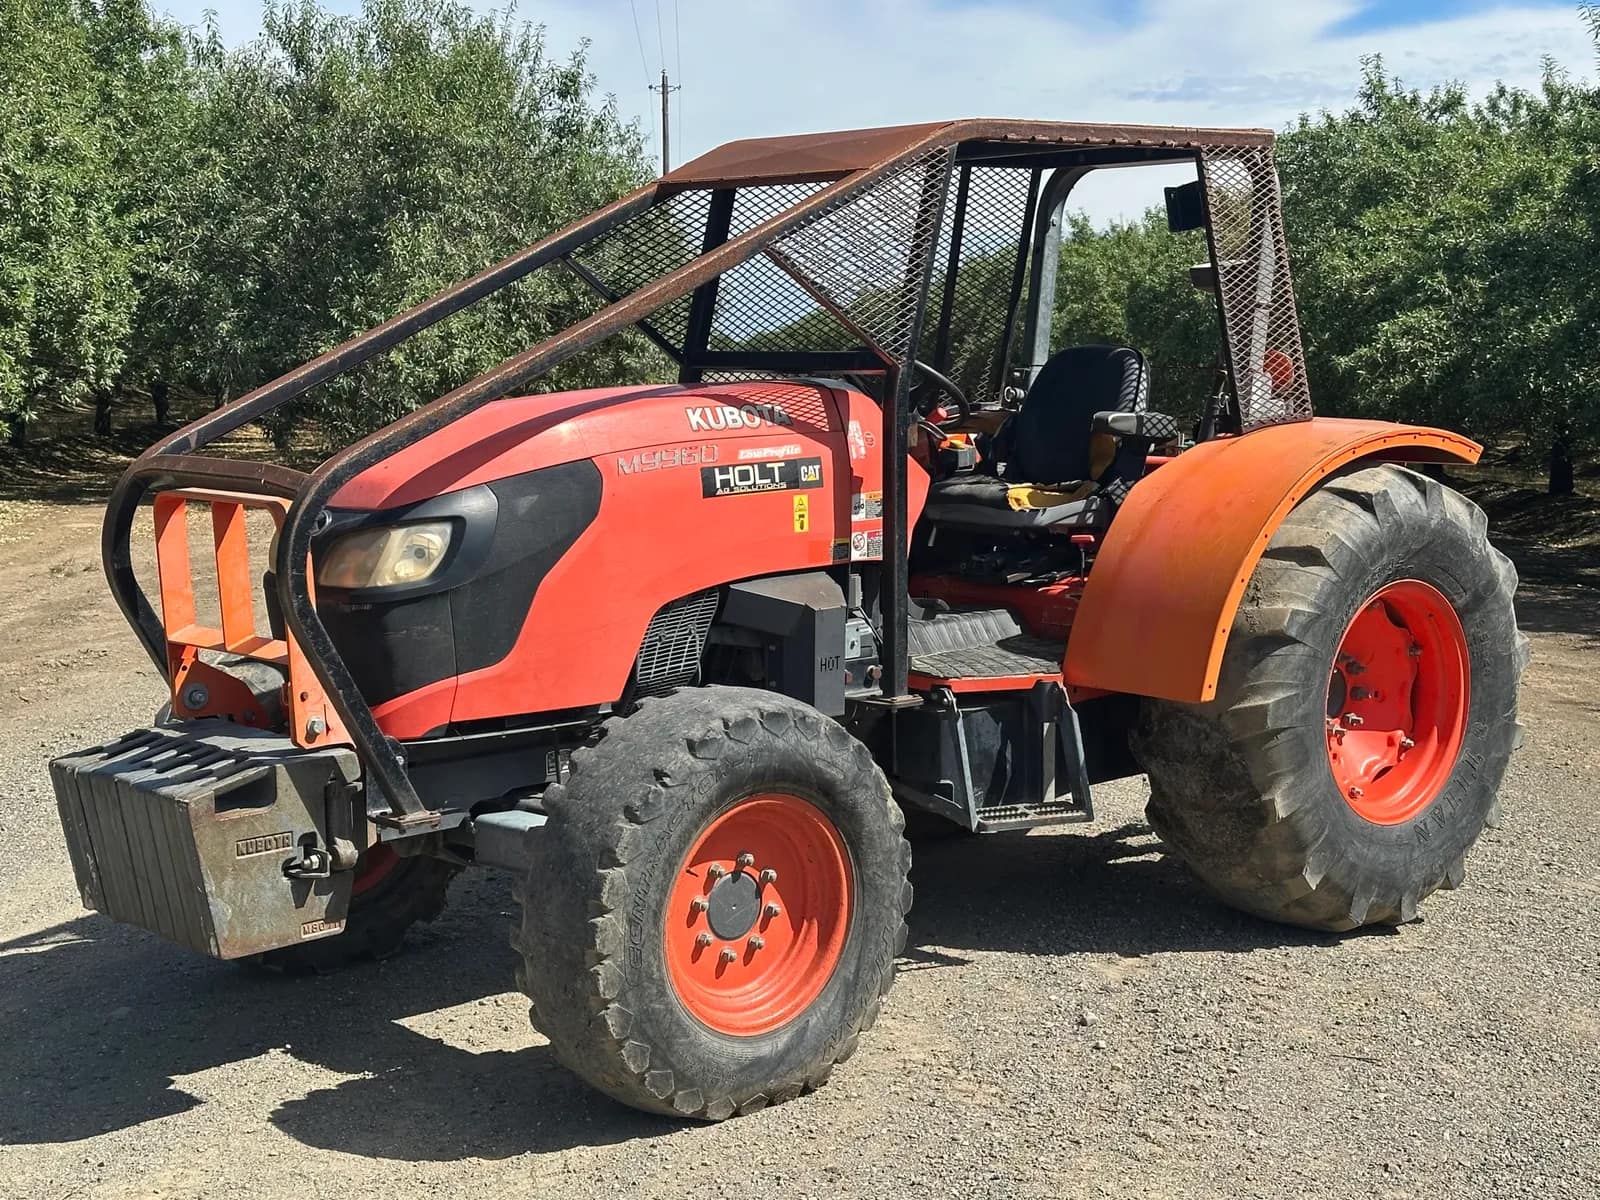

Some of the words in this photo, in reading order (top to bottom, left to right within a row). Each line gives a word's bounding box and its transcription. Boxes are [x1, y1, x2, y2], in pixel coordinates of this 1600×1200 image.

[685, 405, 793, 432] KUBOTA
[617, 444, 719, 476] M9960
[714, 462, 785, 488] HOLT
[800, 465, 820, 481] CAT
[733, 482, 786, 492] SOLUTIONS
[820, 656, 840, 672] HOT
[236, 836, 291, 857] KUBOTA
